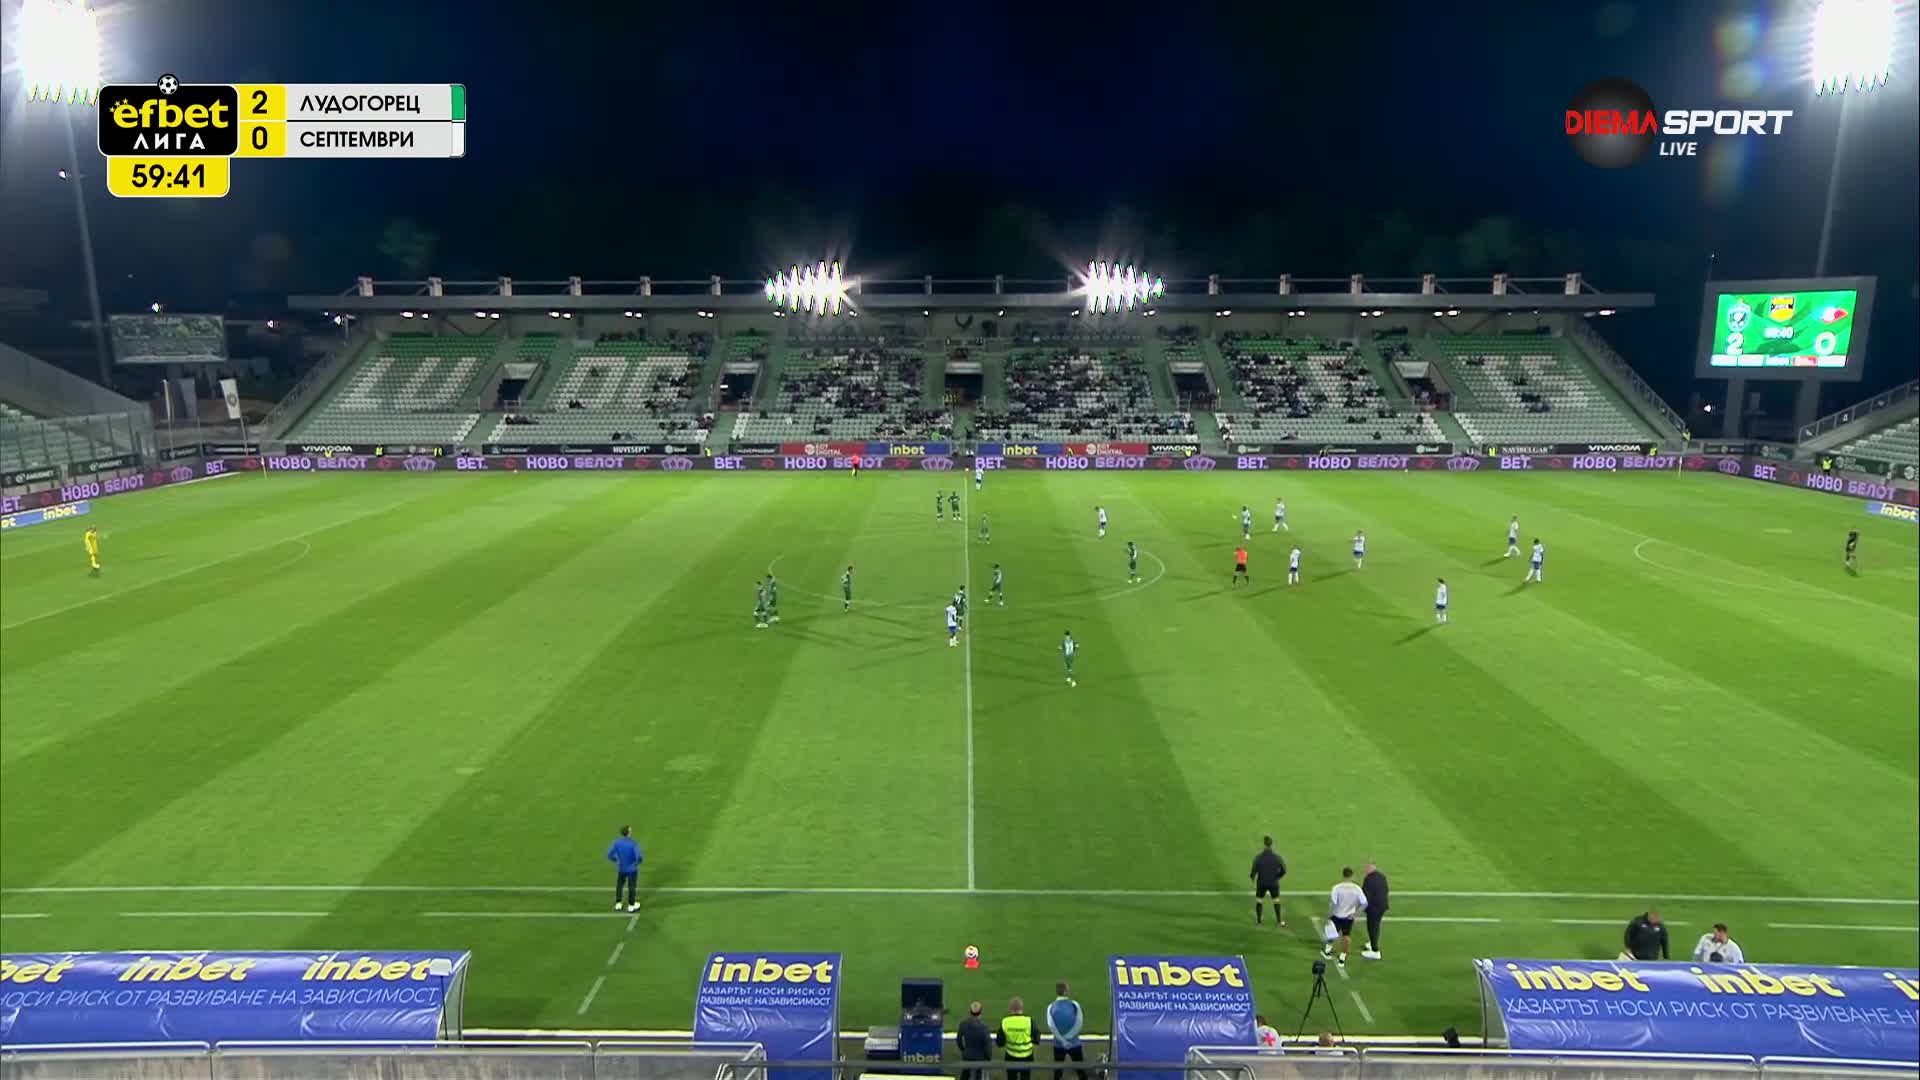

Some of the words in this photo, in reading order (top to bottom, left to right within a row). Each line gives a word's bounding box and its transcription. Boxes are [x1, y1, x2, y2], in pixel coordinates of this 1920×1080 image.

[1726, 333, 1744, 355] 2
[1815, 331, 1836, 355] 0
[889, 443, 925, 456] inbet
[1003, 443, 1039, 456] inbet
[268, 456, 312, 470] НОВО
[317, 457, 368, 470] БЕЛОТ
[526, 456, 569, 470] НОВО
[574, 457, 624, 470] БЕЛОТ
[784, 456, 828, 470] НОВО
[832, 457, 885, 470] БЕОТ
[1045, 456, 1089, 470] НОВО
[1095, 456, 1147, 470] БЕЛОТ
[1308, 456, 1351, 470] НОВО
[1357, 456, 1409, 470] БЕЛОТ
[1572, 456, 1617, 470] НОВО
[1623, 456, 1676, 469] БЕЛОТ
[61, 482, 100, 502] НОВО
[103, 474, 145, 493] БЕЛОТ
[1807, 472, 1843, 493] НОВО
[1848, 480, 1896, 501] БЕЛОТ
[118, 955, 258, 983] inbet
[301, 954, 431, 982] inbet
[707, 956, 834, 984] inbet
[1114, 959, 1245, 988] inbet
[1506, 963, 1650, 993] inbet
[1689, 967, 1845, 999] inbet
[56, 989, 115, 1006] РИСК
[115, 989, 146, 1006] ОТ
[146, 988, 264, 1007] РАЗВИВАНЕ
[269, 988, 300, 1006] НА
[301, 987, 438, 1005] ЗАВИСИМОСТ
[701, 986, 751, 996] ХАЗАРТЪТ
[754, 986, 785, 996] НОСИ
[788, 986, 816, 996] РИСК
[818, 986, 831, 996] ОТ
[1118, 991, 1169, 1001] ХАЗАРТЪТ
[1172, 992, 1202, 1001] НОСИ
[1205, 992, 1234, 1002] РИСК
[1236, 992, 1249, 1002] ОТ
[700, 996, 752, 1006] РАЗВИВАНЕ
[755, 996, 769, 1006] НА
[769, 996, 831, 1006] ЗАВИСИМОСТ
[1119, 1001, 1173, 1011] РАЗВИВАНЕ
[1174, 1002, 1188, 1011] НА
[1188, 1002, 1251, 1012] ЗАВИСИМОСТ
[1505, 998, 1599, 1017] ХАЗАРТЪТ
[1607, 1000, 1671, 1018] НОСИ
[1673, 1002, 1727, 1019] РИСК
[1730, 1003, 1758, 1020] ОТ
[1764, 1003, 1896, 1025] РАЗВИВАНЕ
[1896, 1007, 1919, 1025] Н
